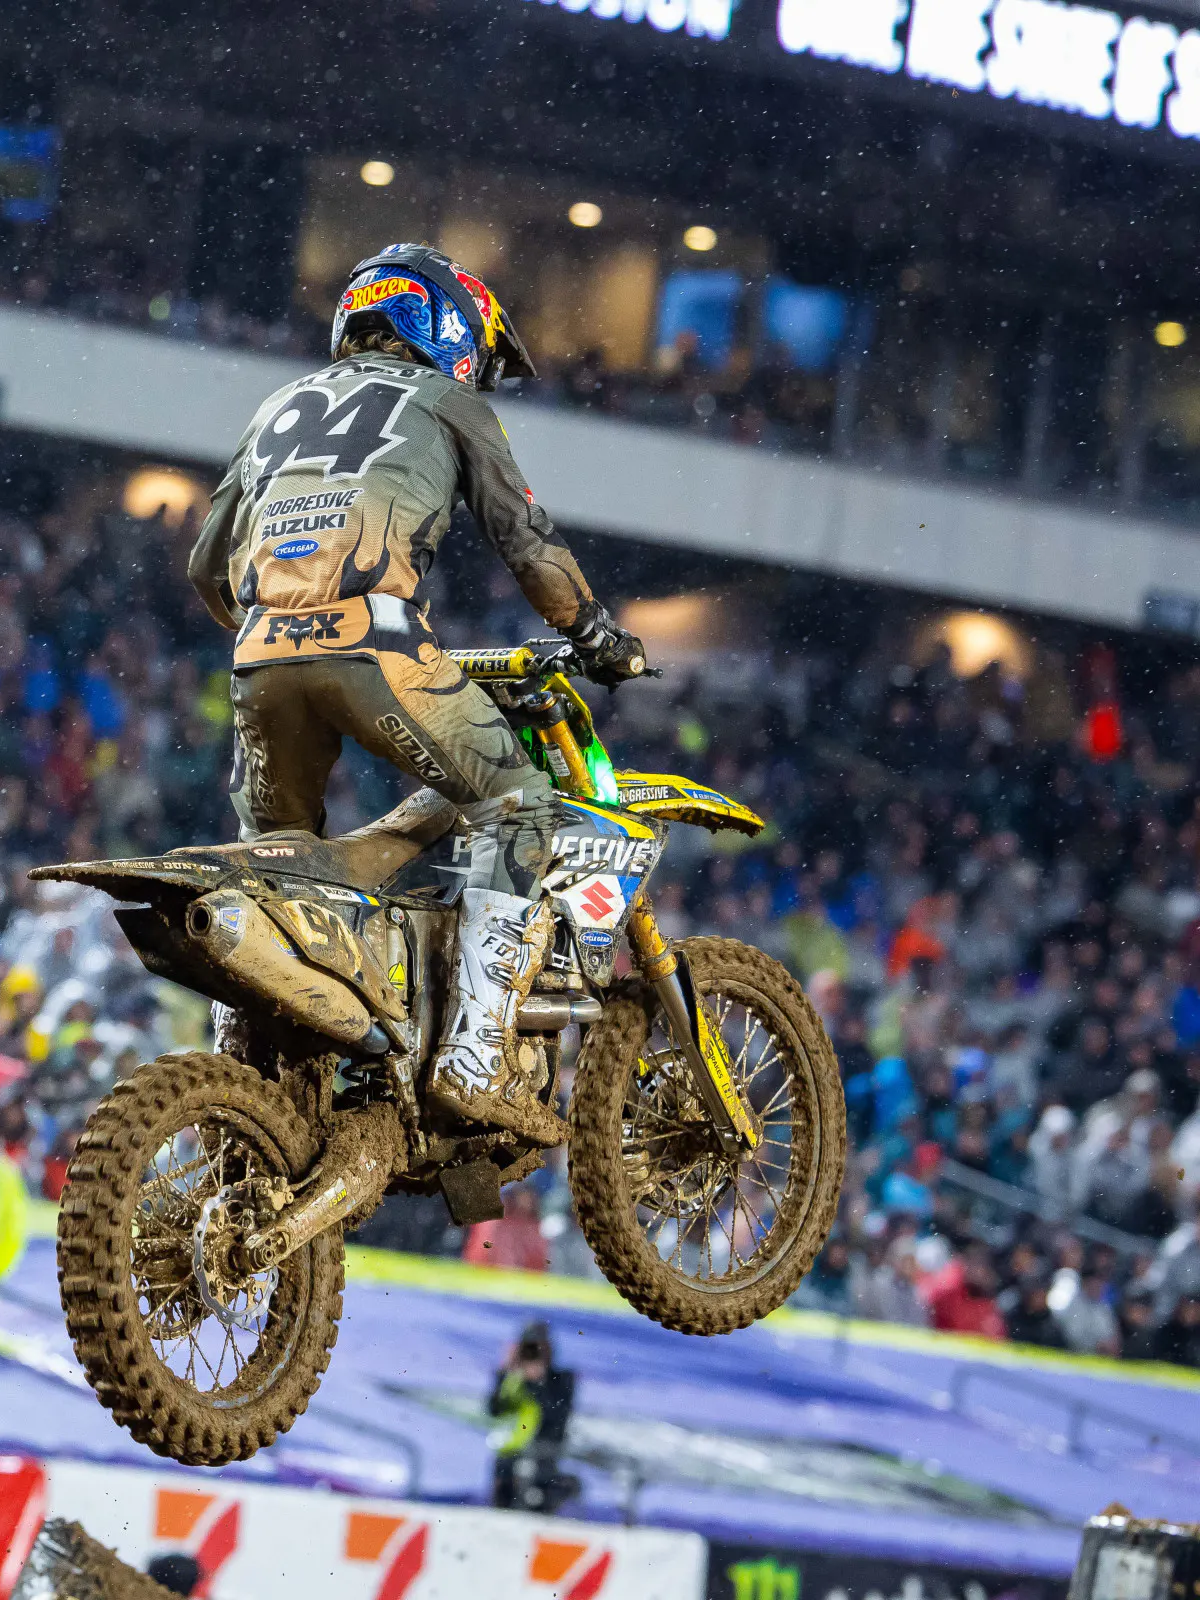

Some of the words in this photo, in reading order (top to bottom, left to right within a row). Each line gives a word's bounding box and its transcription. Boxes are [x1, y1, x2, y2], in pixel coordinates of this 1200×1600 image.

[252, 378, 419, 506] 94
[274, 546, 295, 556] CYCLE
[296, 543, 316, 553] GEAR
[253, 847, 296, 857] GUTS
